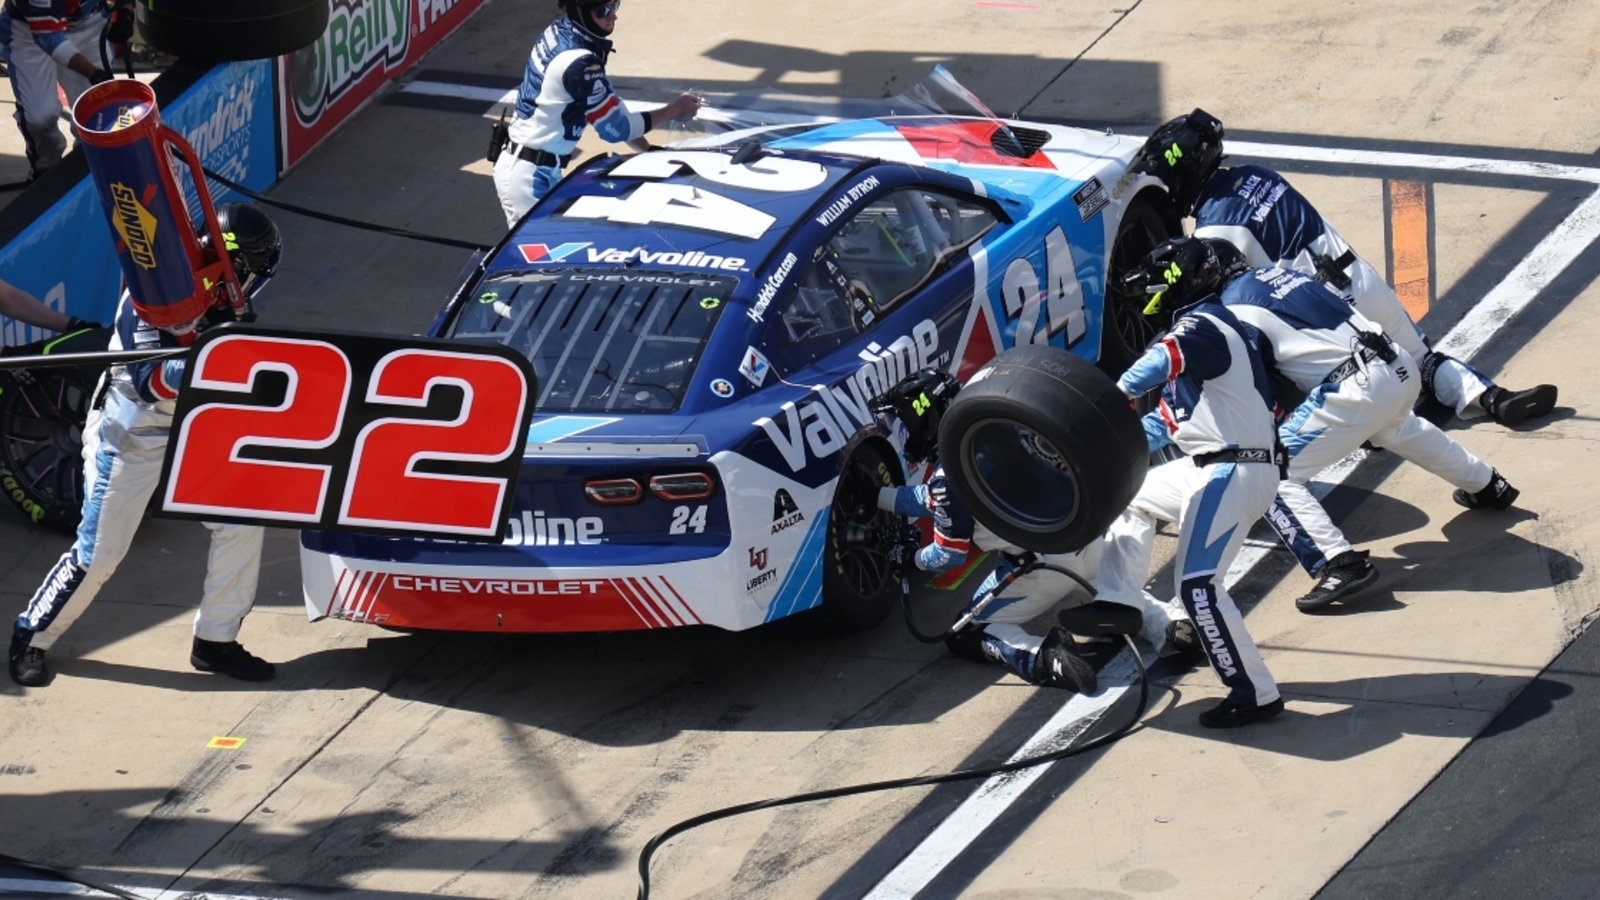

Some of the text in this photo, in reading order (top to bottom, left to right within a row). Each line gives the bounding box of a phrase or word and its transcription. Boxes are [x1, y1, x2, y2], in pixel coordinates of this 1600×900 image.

[1164, 142, 1184, 167] 24
[562, 148, 829, 240] 24
[815, 174, 881, 228] WILLIAM BYRON
[113, 187, 152, 268] SUNOCO
[221, 232, 239, 251] 24
[587, 246, 747, 271] Valvoline
[1164, 261, 1183, 285] 24
[569, 274, 722, 287] CHEVROLET
[746, 251, 799, 324] HendrickCars.com
[1002, 225, 1087, 347] 24
[752, 318, 939, 472] Valvoline
[912, 392, 931, 417] 24
[162, 334, 528, 536] 22
[669, 505, 708, 535] 24
[771, 512, 805, 535] AXALTA
[28, 556, 78, 627] Valvoline
[392, 576, 604, 595] CHEVROLET
[746, 567, 778, 591] LIBERTY
[1191, 587, 1238, 678] Valvoline
